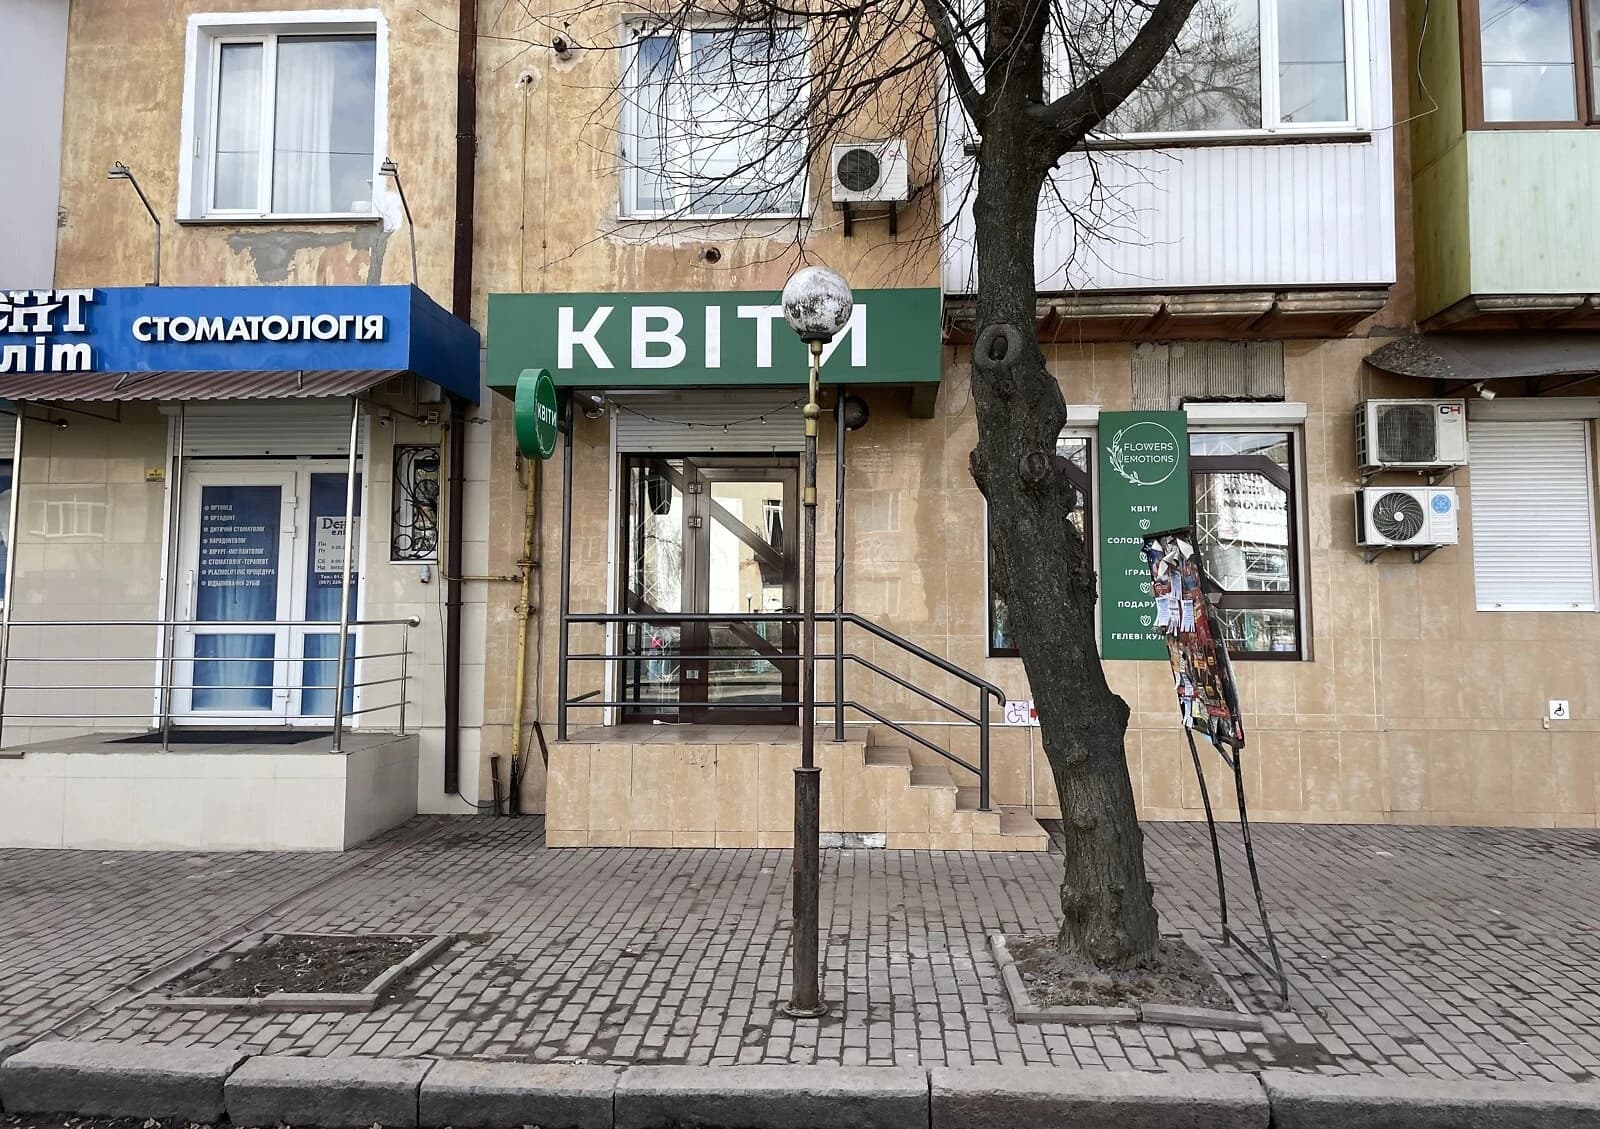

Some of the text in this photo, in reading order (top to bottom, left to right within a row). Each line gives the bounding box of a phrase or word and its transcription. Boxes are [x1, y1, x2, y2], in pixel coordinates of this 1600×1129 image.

[131, 313, 385, 343] СТОМАТОЛОГІЯ
[556, 302, 868, 370] КВІТИ
[536, 401, 558, 428] КВІТИ
[1439, 405, 1462, 416] CH
[1123, 442, 1174, 451] FLOWERS
[1123, 455, 1175, 463] EMOTIONS
[1130, 504, 1158, 513] КВІТИ
[1117, 601, 1156, 609] ПОДАРУ
[1111, 632, 1143, 640] ГЕЛЕВІ
